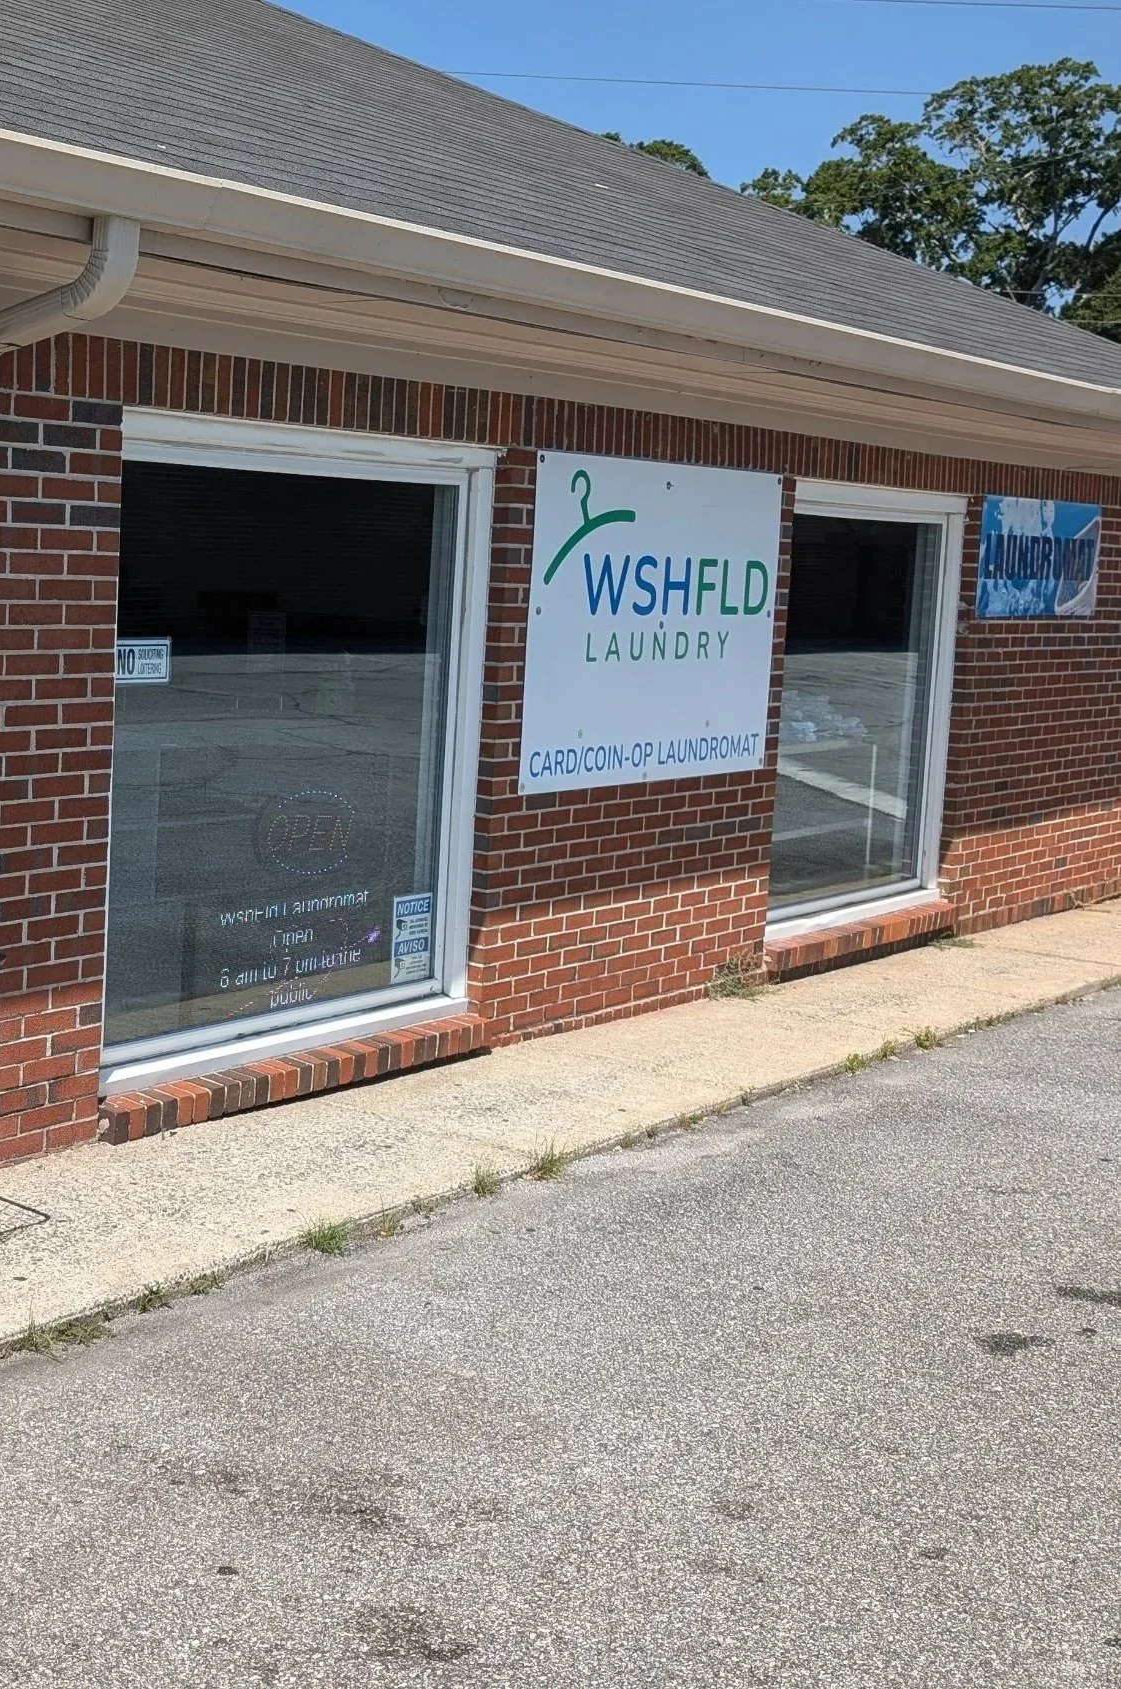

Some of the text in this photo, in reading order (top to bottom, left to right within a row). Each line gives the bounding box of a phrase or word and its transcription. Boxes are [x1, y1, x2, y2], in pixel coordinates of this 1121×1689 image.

[984, 534, 1095, 581] LAUNDROMAT
[583, 553, 769, 616] WSHFLD
[117, 648, 135, 675] NO
[138, 648, 164, 660] SOLICITING
[585, 630, 731, 663] LAUNDRY
[138, 662, 162, 675] LOITERING
[529, 733, 760, 778] CARD/COIN-OP LAUNDROMAT
[267, 814, 353, 851] OPEN
[397, 898, 430, 916] NOTICE
[397, 938, 425, 955] AVISO
